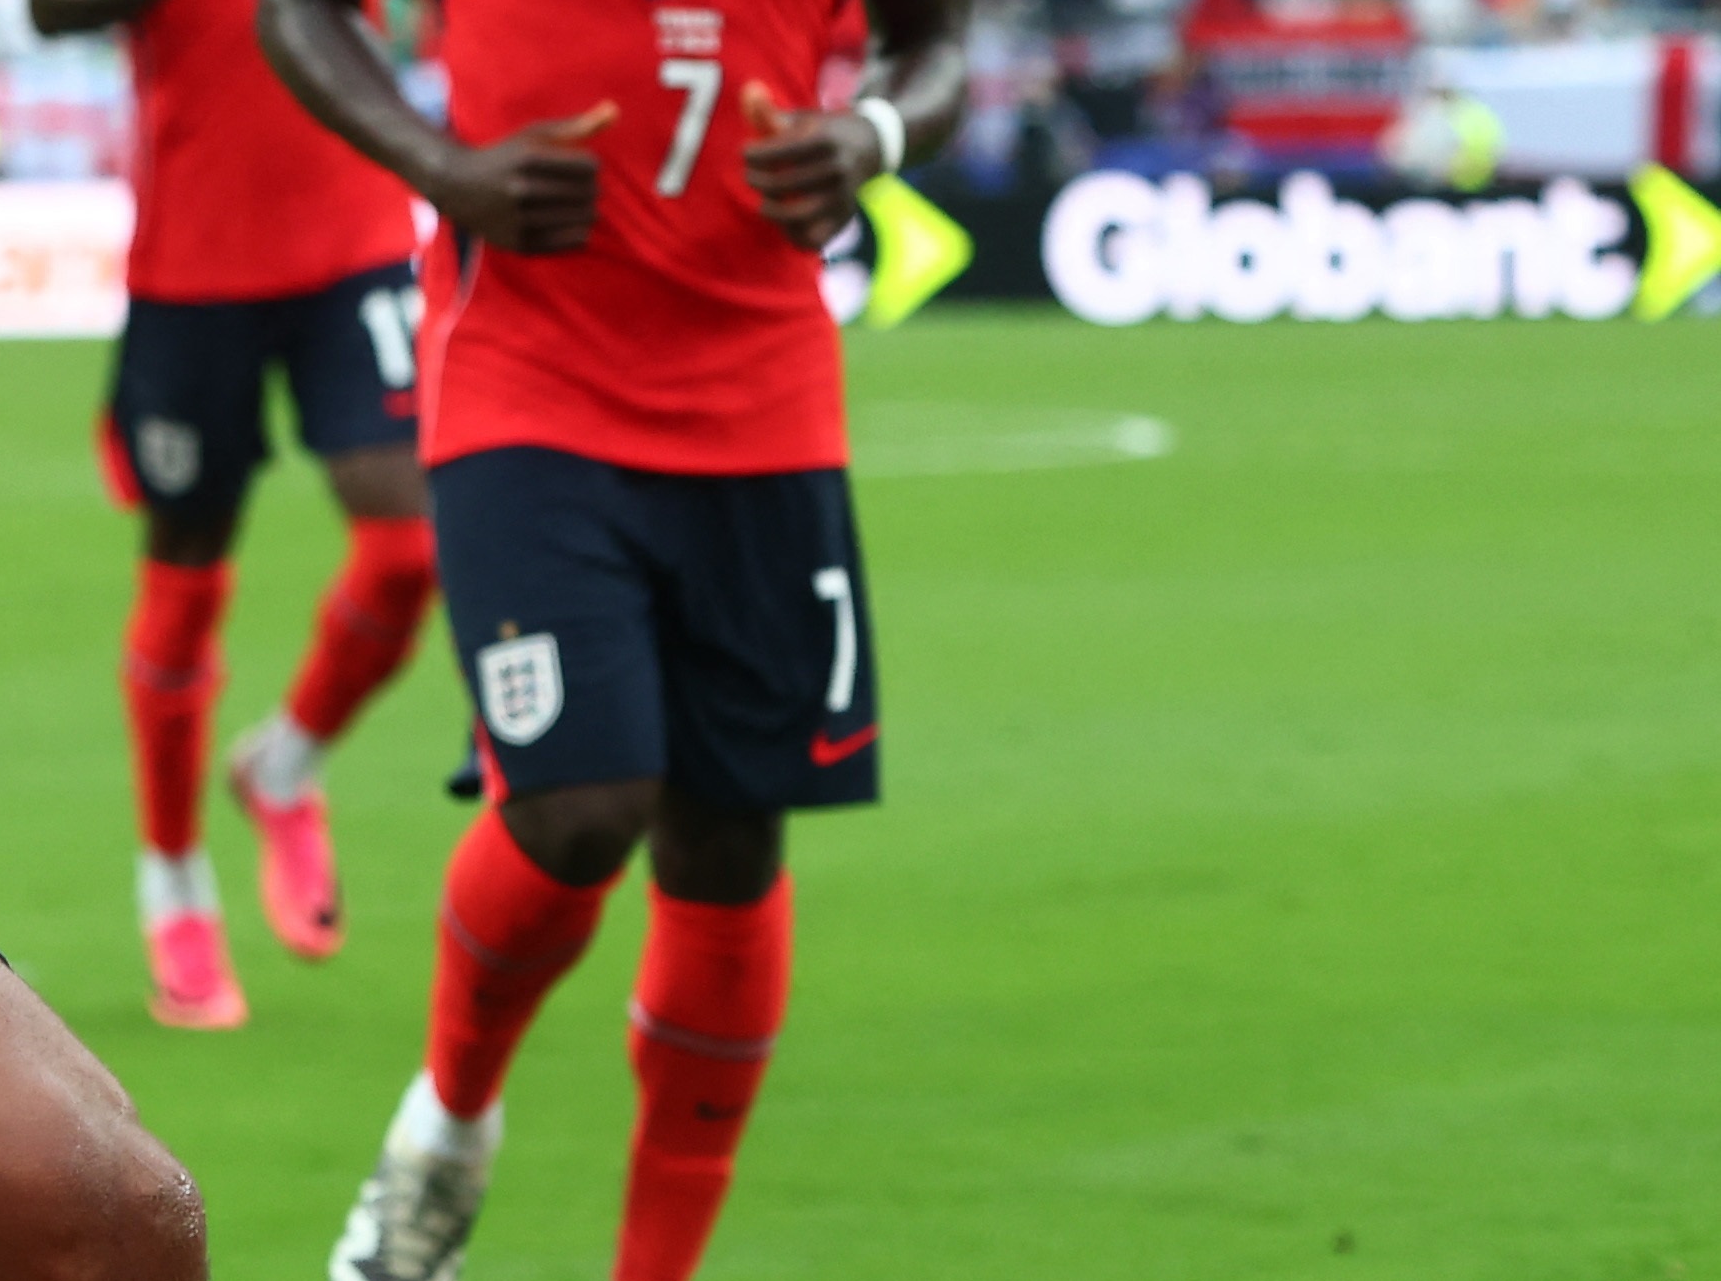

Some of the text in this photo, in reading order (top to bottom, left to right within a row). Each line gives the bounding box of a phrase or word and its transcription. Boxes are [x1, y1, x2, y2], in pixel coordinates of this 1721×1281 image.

[655, 58, 723, 198] 7
[1041, 168, 1640, 325] Globant
[811, 566, 857, 713] 7
